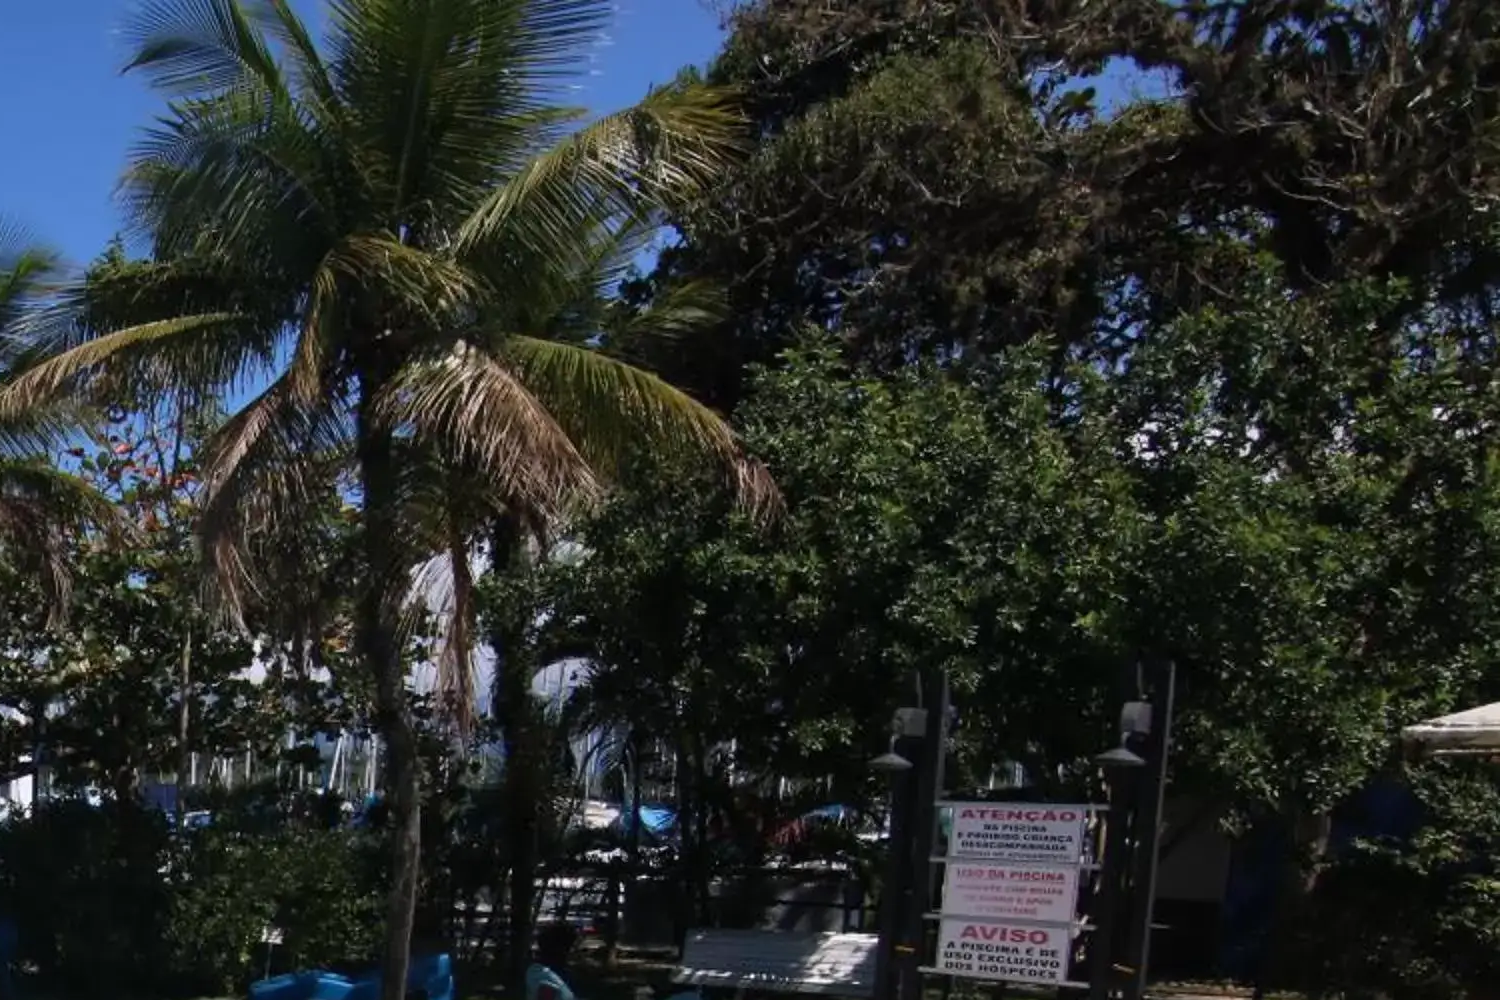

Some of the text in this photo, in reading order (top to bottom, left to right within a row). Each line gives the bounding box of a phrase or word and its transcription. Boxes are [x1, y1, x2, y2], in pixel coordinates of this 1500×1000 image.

[960, 809, 1077, 822] ATENÇÃO
[1002, 824, 1047, 833] PISCINA
[967, 832, 1019, 840] PROIBIDO
[1023, 834, 1073, 843] CRIANÇA
[957, 868, 1065, 881] USO DA PISCINA
[960, 925, 1049, 945] AVISO
[947, 941, 956, 949] A
[961, 942, 1020, 954] PISCINA
[1039, 948, 1059, 958] DE
[944, 951, 1060, 969] USO EXCLUSIVO
[944, 961, 973, 971] DOS
